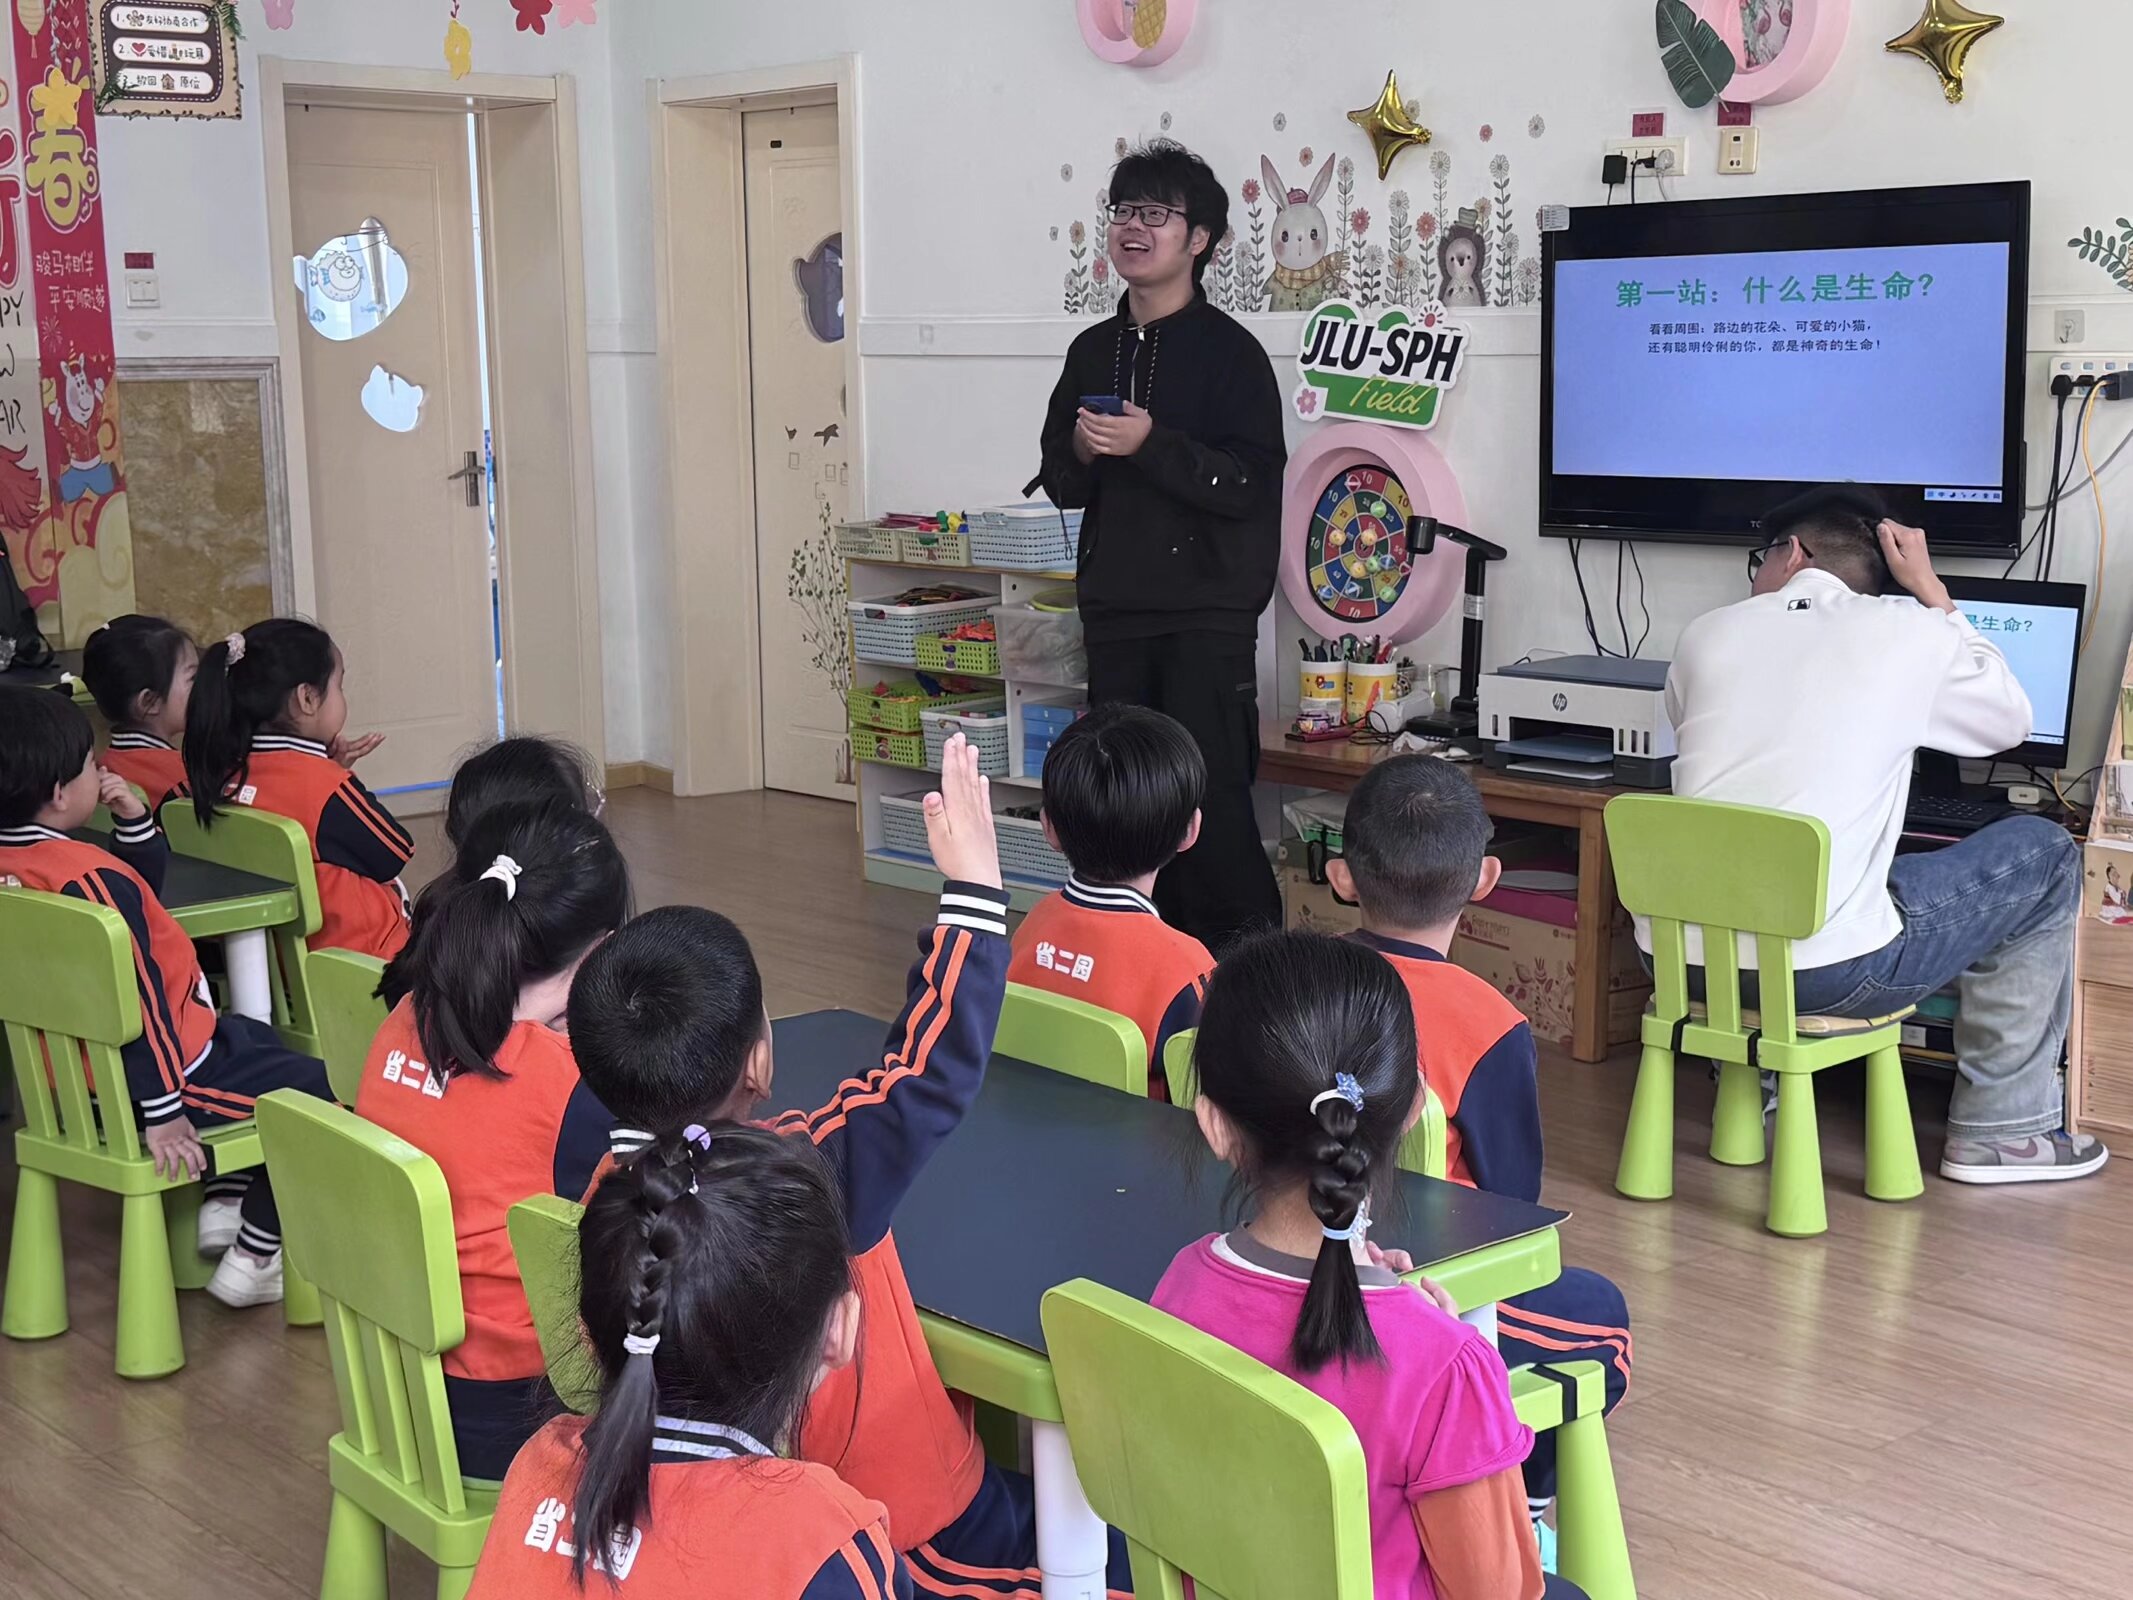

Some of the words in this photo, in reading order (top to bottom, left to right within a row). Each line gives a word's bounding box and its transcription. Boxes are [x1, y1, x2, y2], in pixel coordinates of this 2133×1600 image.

[36, 250, 94, 277] 骏马相伴
[48, 284, 105, 313] 平安顺遂
[1300, 320, 1463, 382] JLU-SPH
[1349, 376, 1436, 413] Field
[1362, 471, 1373, 485] 10
[1327, 490, 1339, 503] 10
[1398, 495, 1410, 508] 10
[1311, 537, 1321, 550] 10
[1348, 607, 1361, 618] 10
[1552, 692, 1568, 712] hp
[1036, 941, 1095, 982] 省二园
